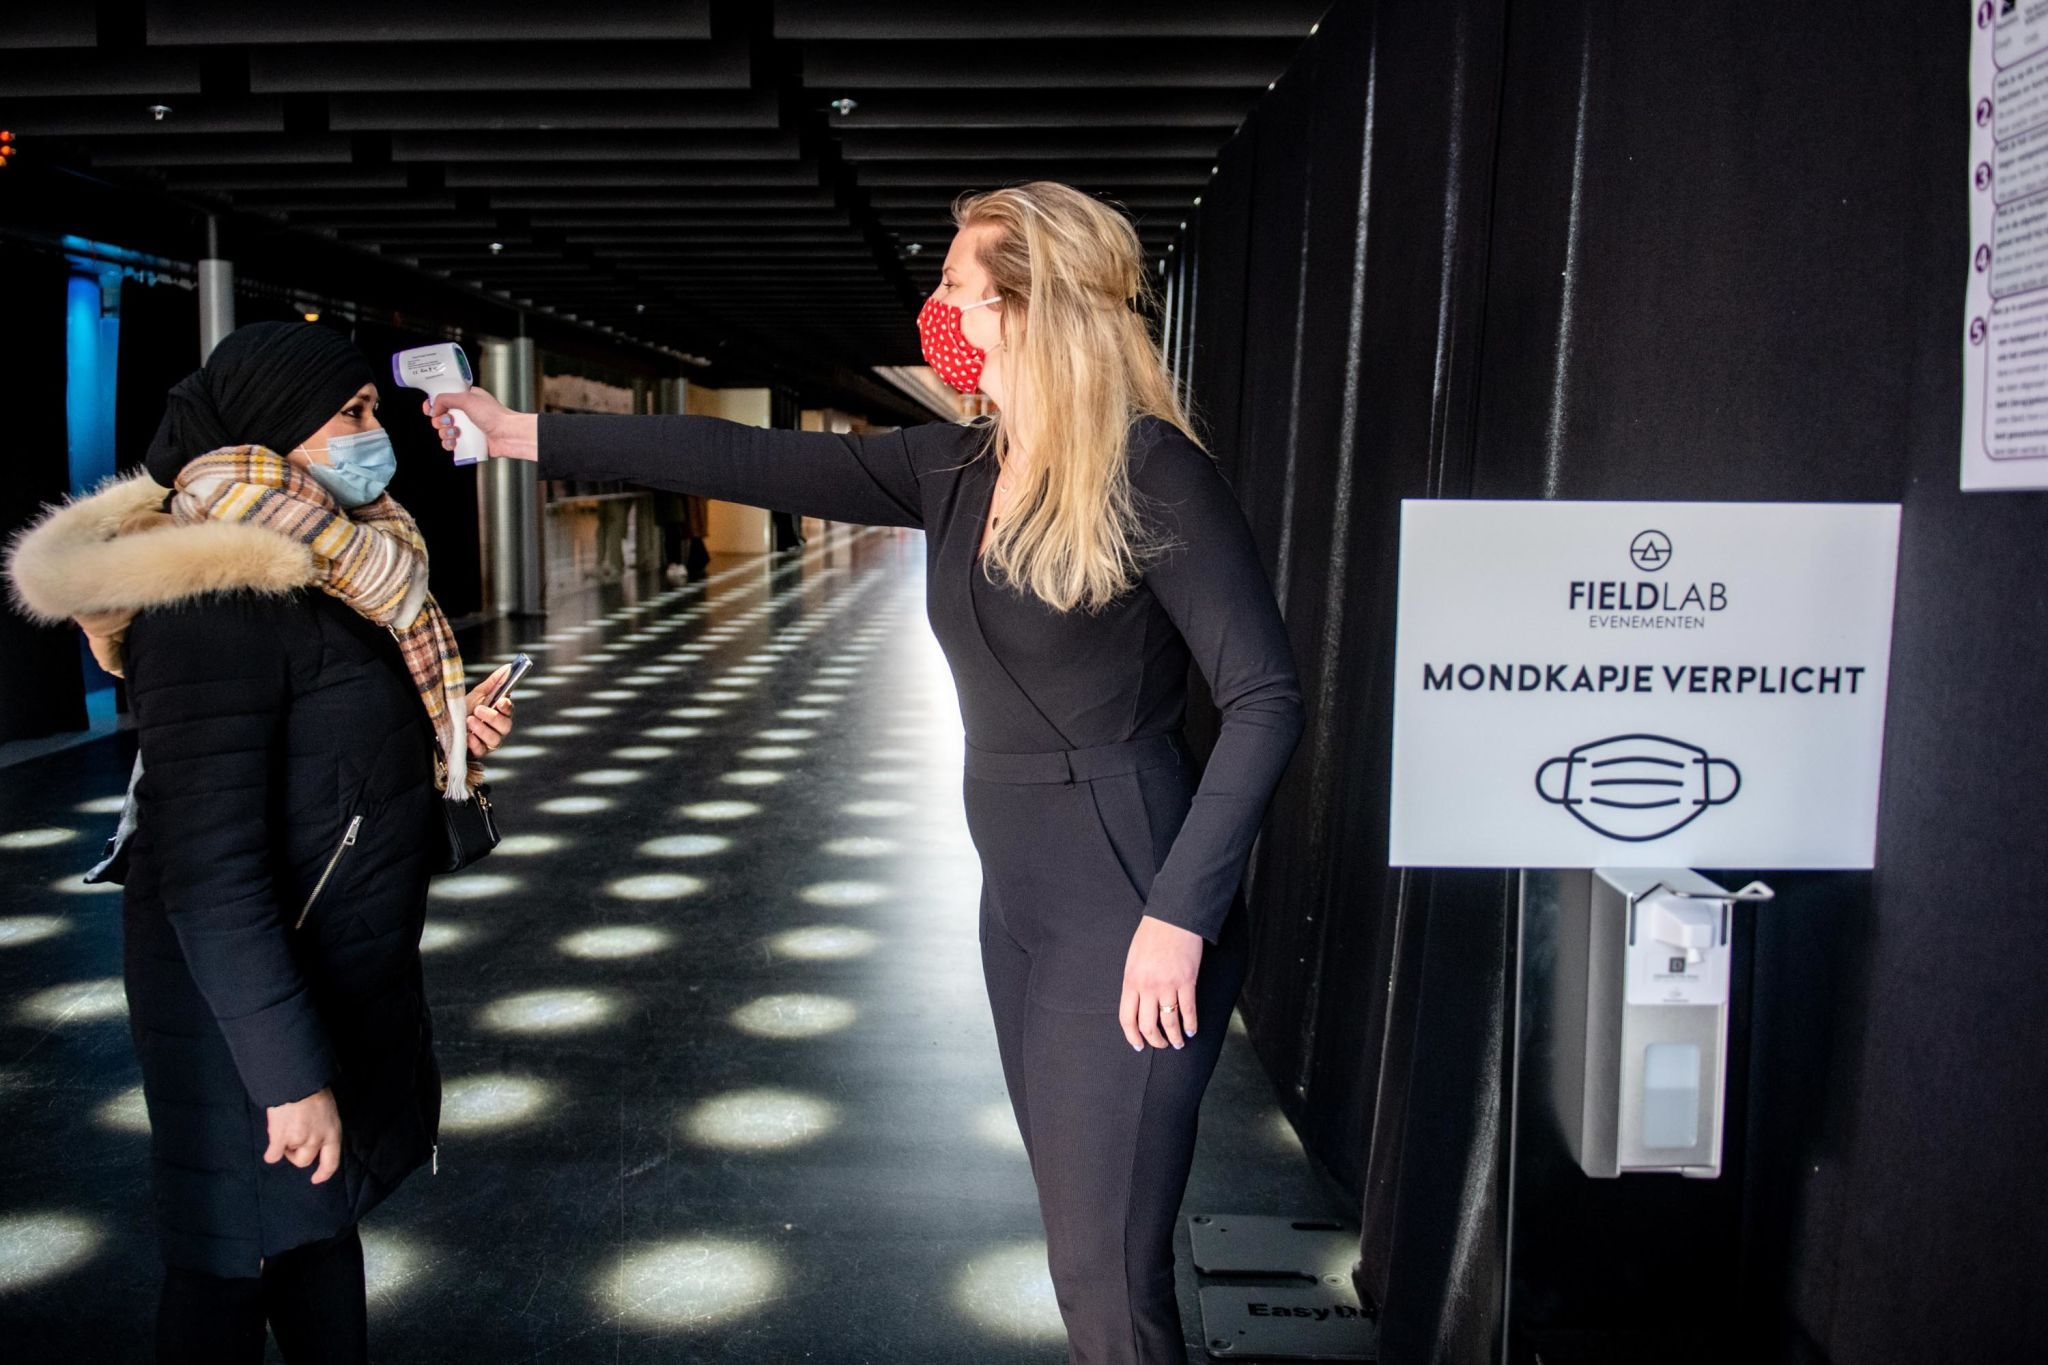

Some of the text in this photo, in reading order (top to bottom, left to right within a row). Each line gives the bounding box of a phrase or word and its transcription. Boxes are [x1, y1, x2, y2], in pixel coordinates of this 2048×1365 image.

[1569, 581, 1728, 611] FIELDLAB
[1589, 615, 1705, 629] EVENEMENTEN
[1423, 663, 1866, 694] MONDKAPJE VERPLICHT
